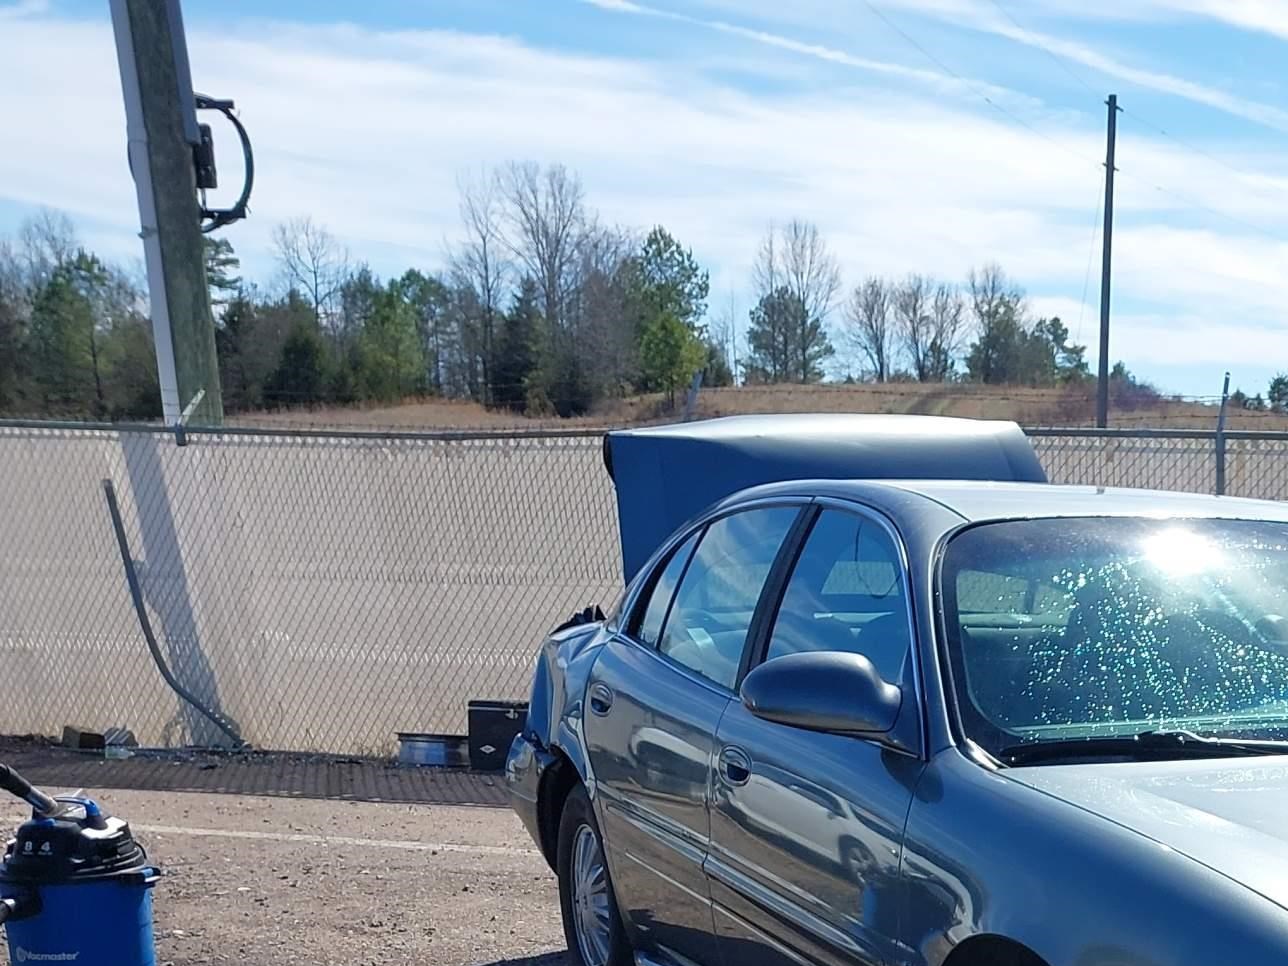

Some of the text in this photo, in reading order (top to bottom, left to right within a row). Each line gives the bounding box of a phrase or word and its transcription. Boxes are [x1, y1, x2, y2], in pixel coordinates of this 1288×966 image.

[25, 841, 51, 851] 8 4
[24, 950, 77, 960] Vacmaster
